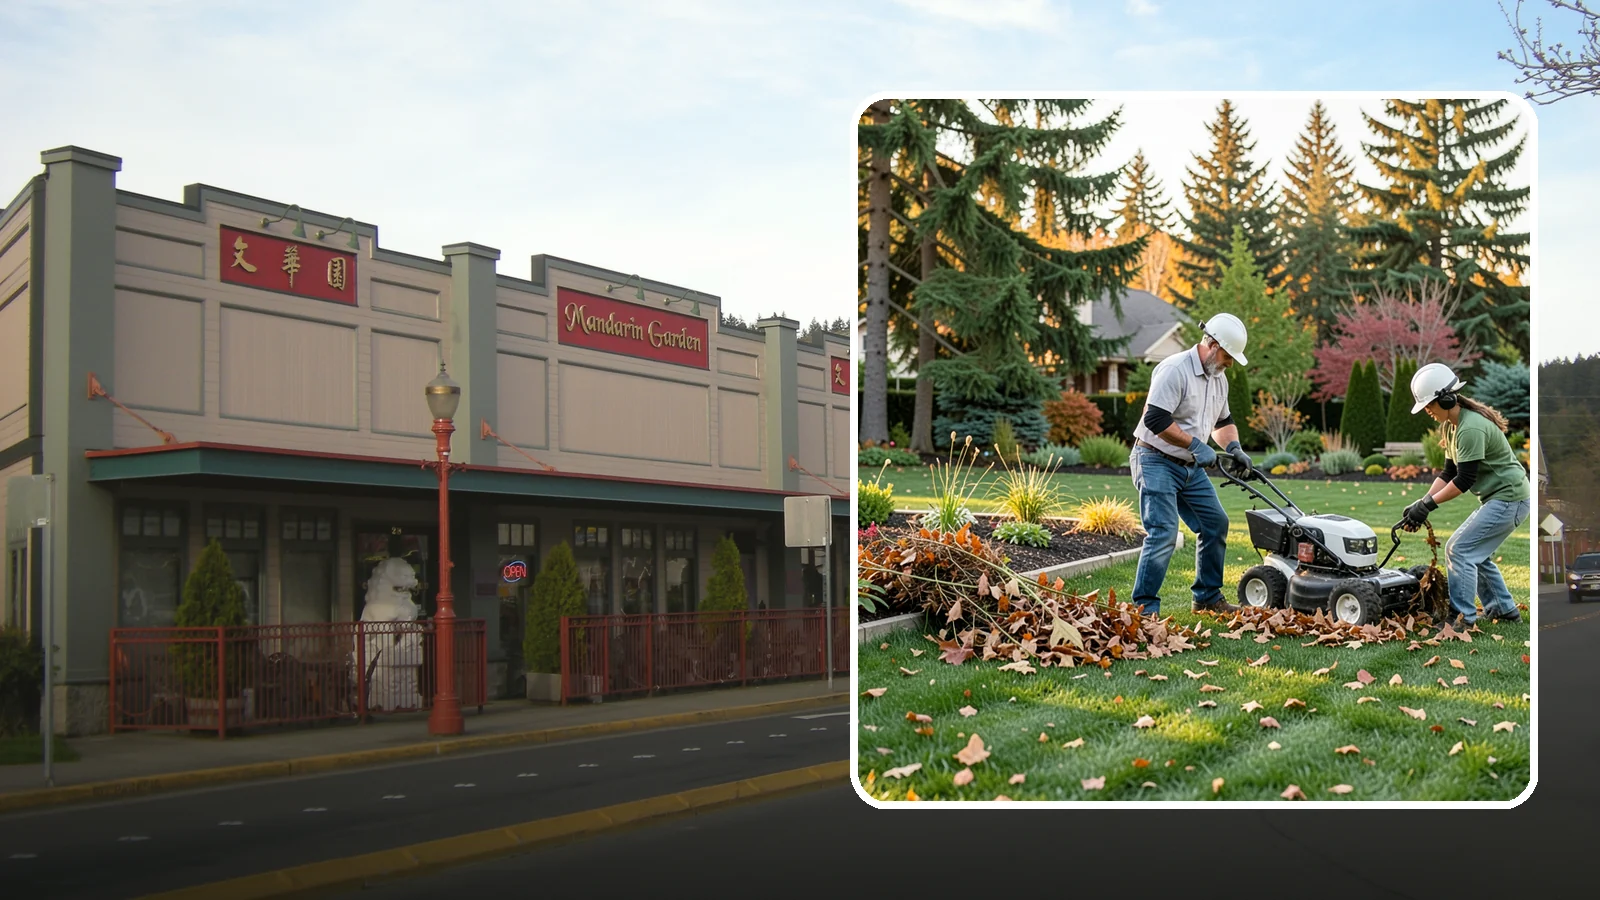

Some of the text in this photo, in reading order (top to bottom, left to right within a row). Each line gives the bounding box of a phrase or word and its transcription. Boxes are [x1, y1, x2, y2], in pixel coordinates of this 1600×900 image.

[231, 236, 346, 291] 文華園
[564, 302, 701, 352] Mandarin Garden
[503, 565, 527, 578] OPEN
